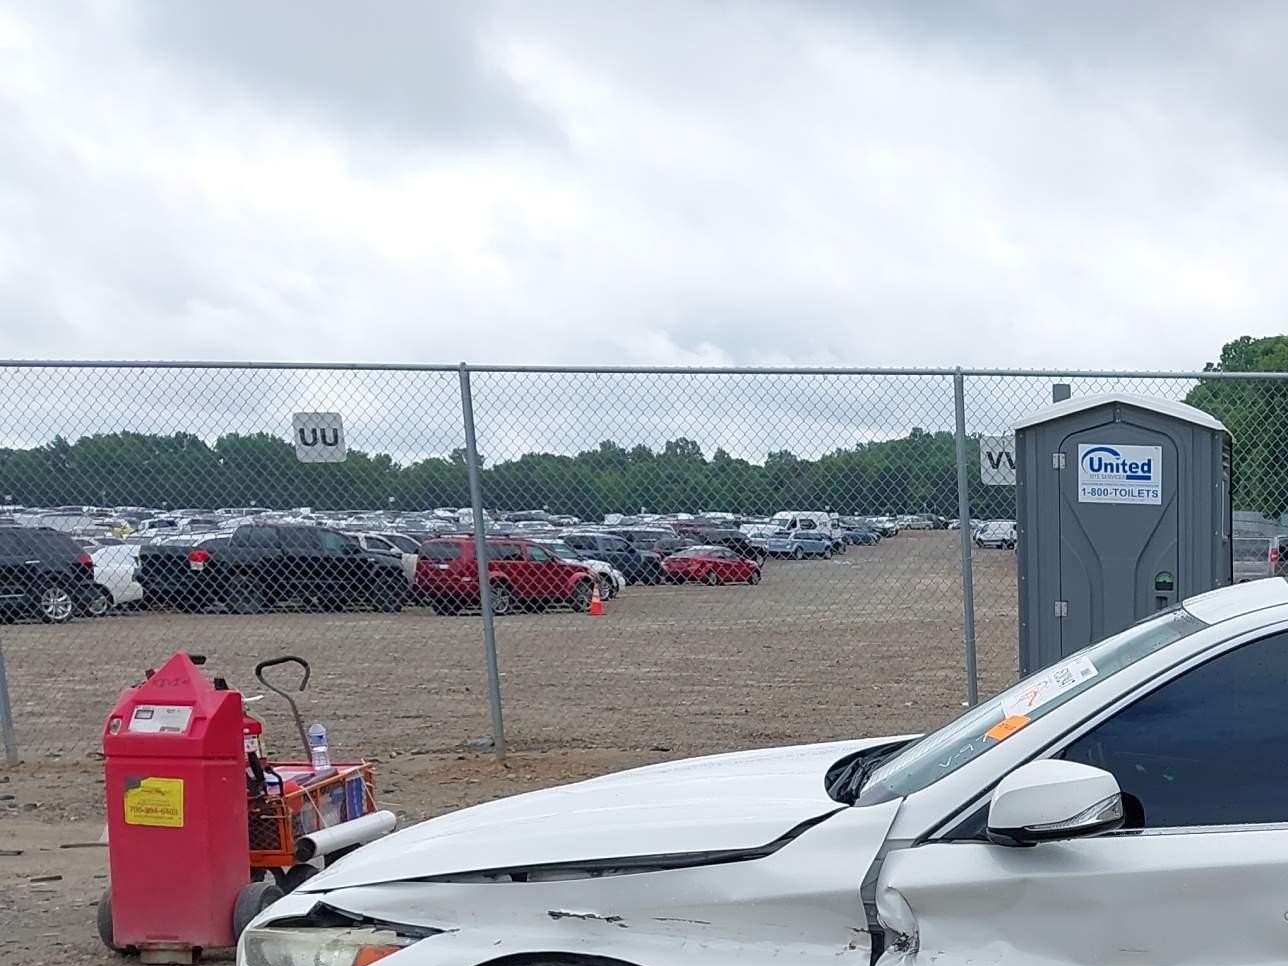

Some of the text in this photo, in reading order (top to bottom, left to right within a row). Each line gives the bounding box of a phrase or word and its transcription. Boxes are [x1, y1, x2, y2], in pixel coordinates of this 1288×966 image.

[299, 428, 338, 447] UU
[1089, 456, 1152, 474] United
[1081, 487, 1159, 498] 1-800-TOILETS
